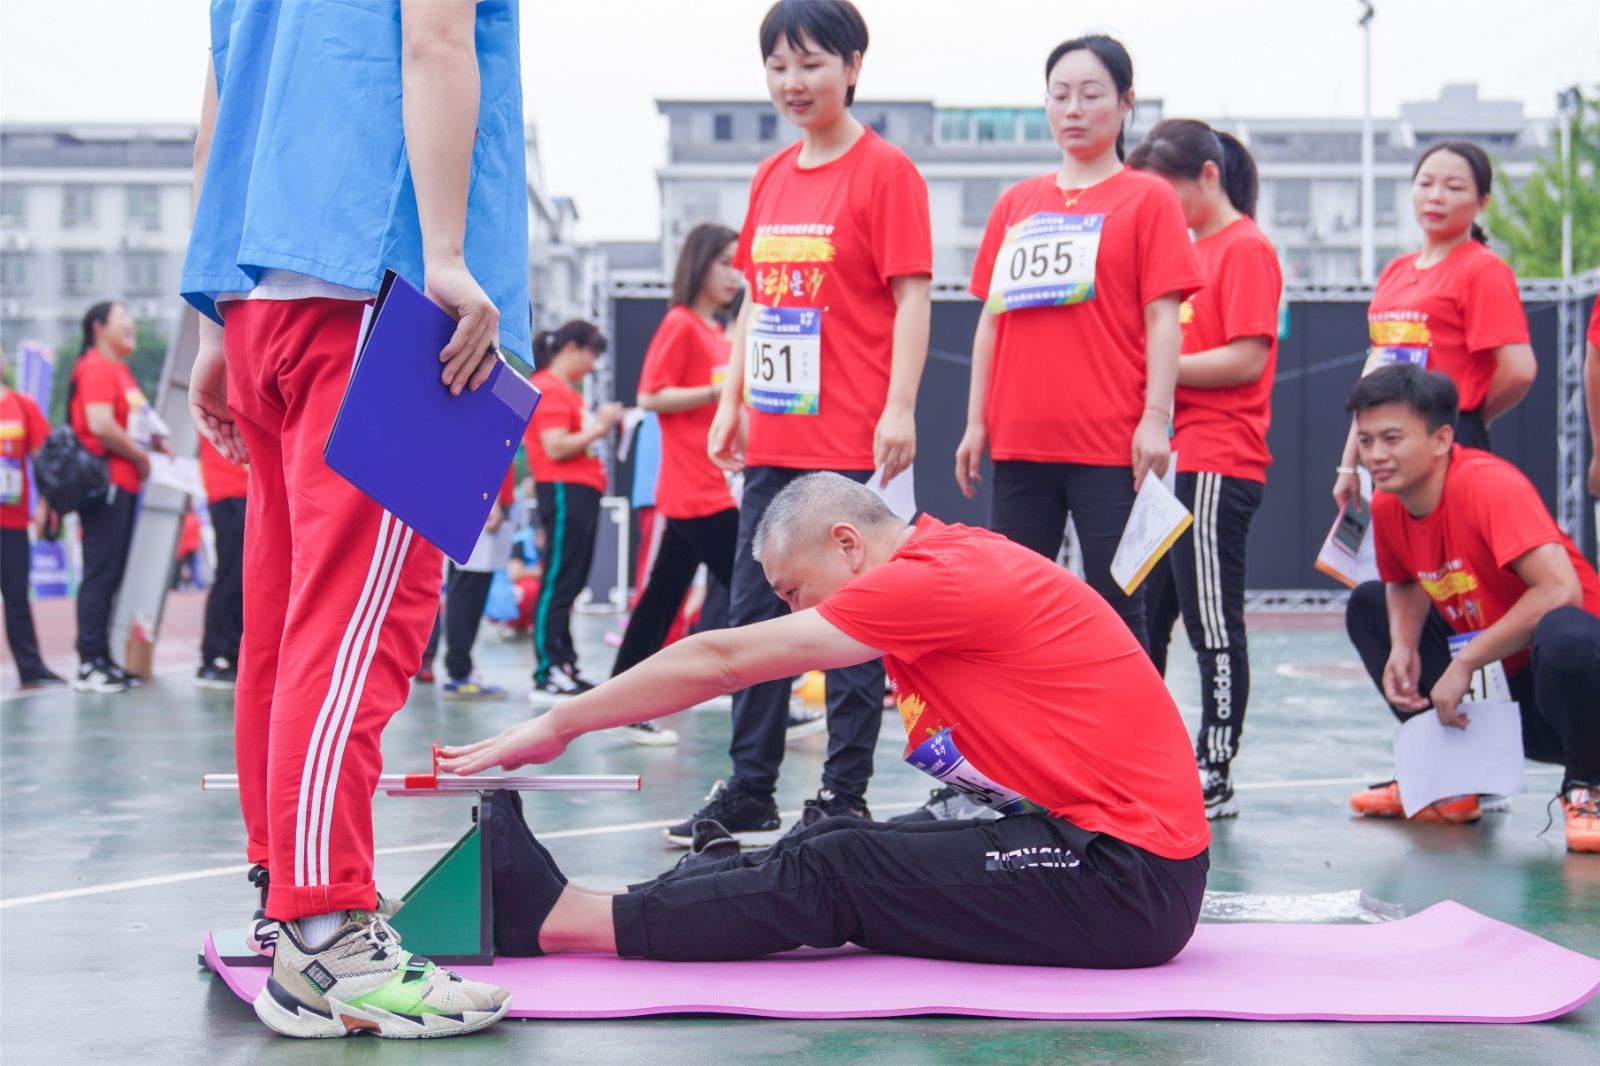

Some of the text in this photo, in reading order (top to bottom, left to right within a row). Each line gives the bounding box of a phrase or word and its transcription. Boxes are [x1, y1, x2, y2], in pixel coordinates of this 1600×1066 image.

[1010, 241, 1073, 282] 055
[751, 340, 792, 384] 051
[1213, 652, 1232, 720] adidas
